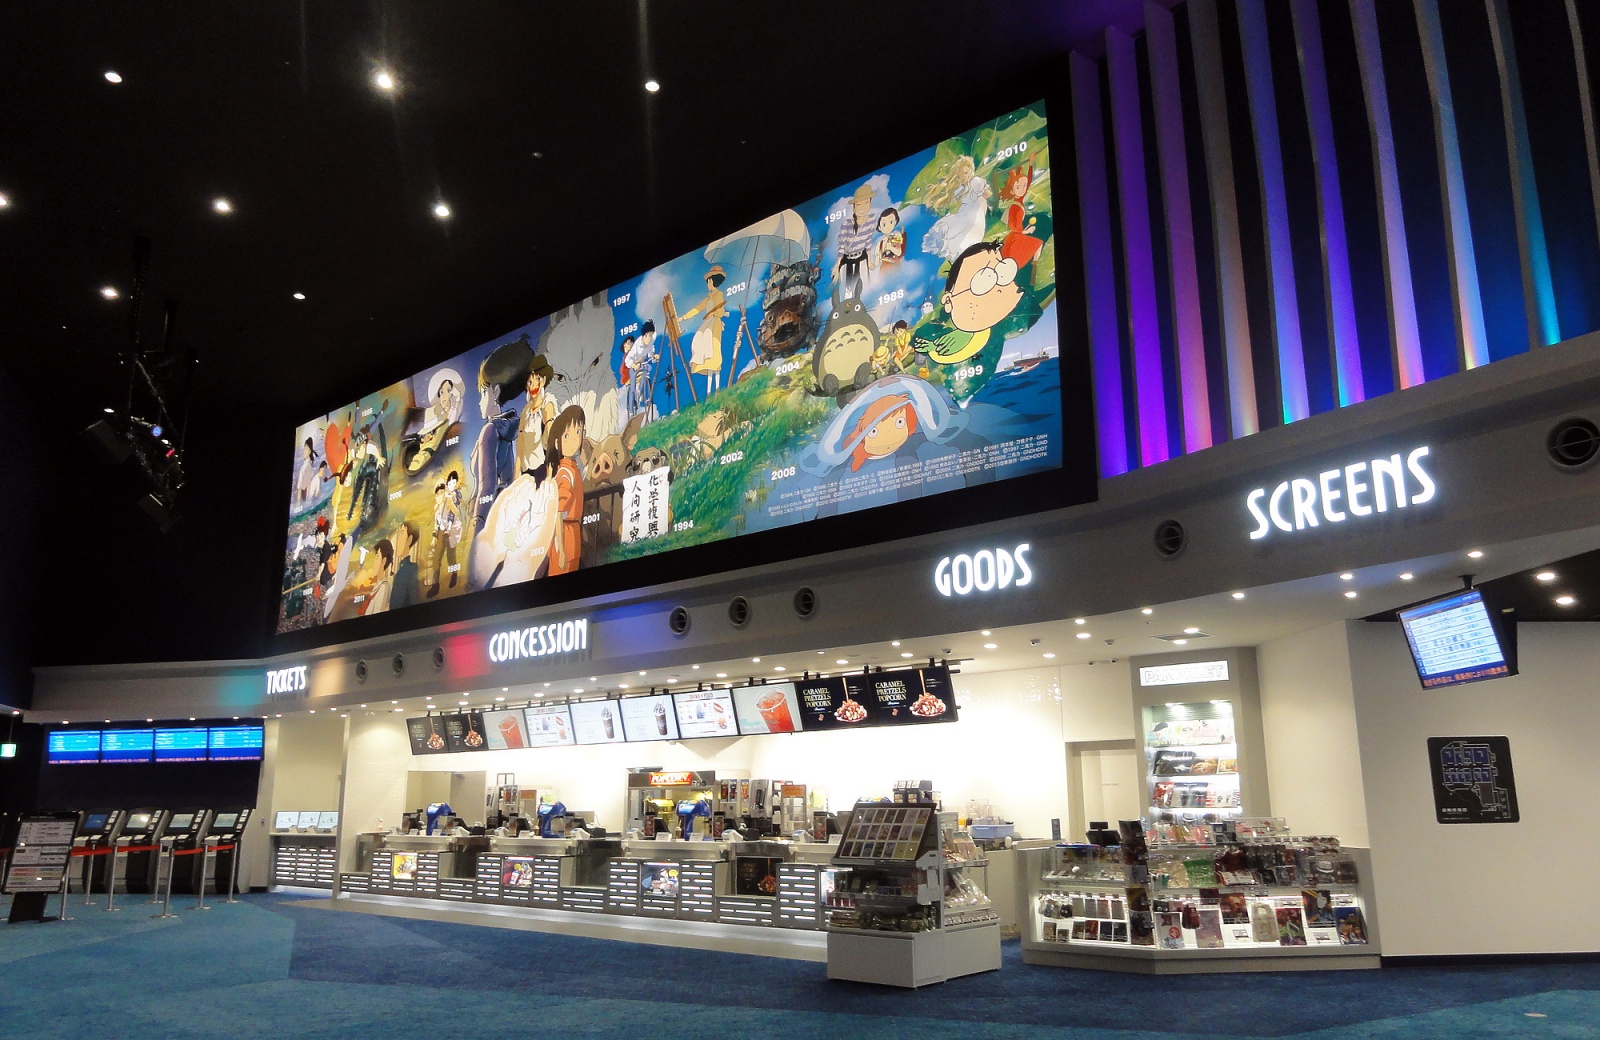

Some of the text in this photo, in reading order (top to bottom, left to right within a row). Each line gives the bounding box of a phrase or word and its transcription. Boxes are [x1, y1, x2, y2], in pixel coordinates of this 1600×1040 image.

[997, 141, 1028, 161] 2010
[824, 208, 848, 225] 1991
[726, 281, 746, 297] 2013
[612, 292, 631, 308] 1997
[877, 289, 904, 306] 1988
[619, 322, 638, 337] 1995
[775, 359, 800, 376] 2004
[953, 364, 983, 382] 1999
[445, 435, 460, 447] 1992
[719, 450, 743, 466] 2002
[770, 465, 796, 482] 2008
[1246, 446, 1436, 540] SCREENS
[582, 512, 600, 525] 2001
[673, 518, 694, 532] 1994
[530, 546, 545, 557] 2013
[934, 543, 1032, 597] GOODS
[353, 594, 365, 604] 2011
[488, 618, 588, 662] CONCESSION
[266, 665, 307, 695] TICKETS
[875, 680, 906, 689] CARAMEL
[802, 687, 830, 695] CARAMEL
[804, 694, 832, 702] PRETZELS
[877, 687, 907, 695] PRETZELS
[878, 693, 907, 702] POPCORN
[806, 700, 832, 708] POPCORN
[651, 774, 689, 783] POPCORN
